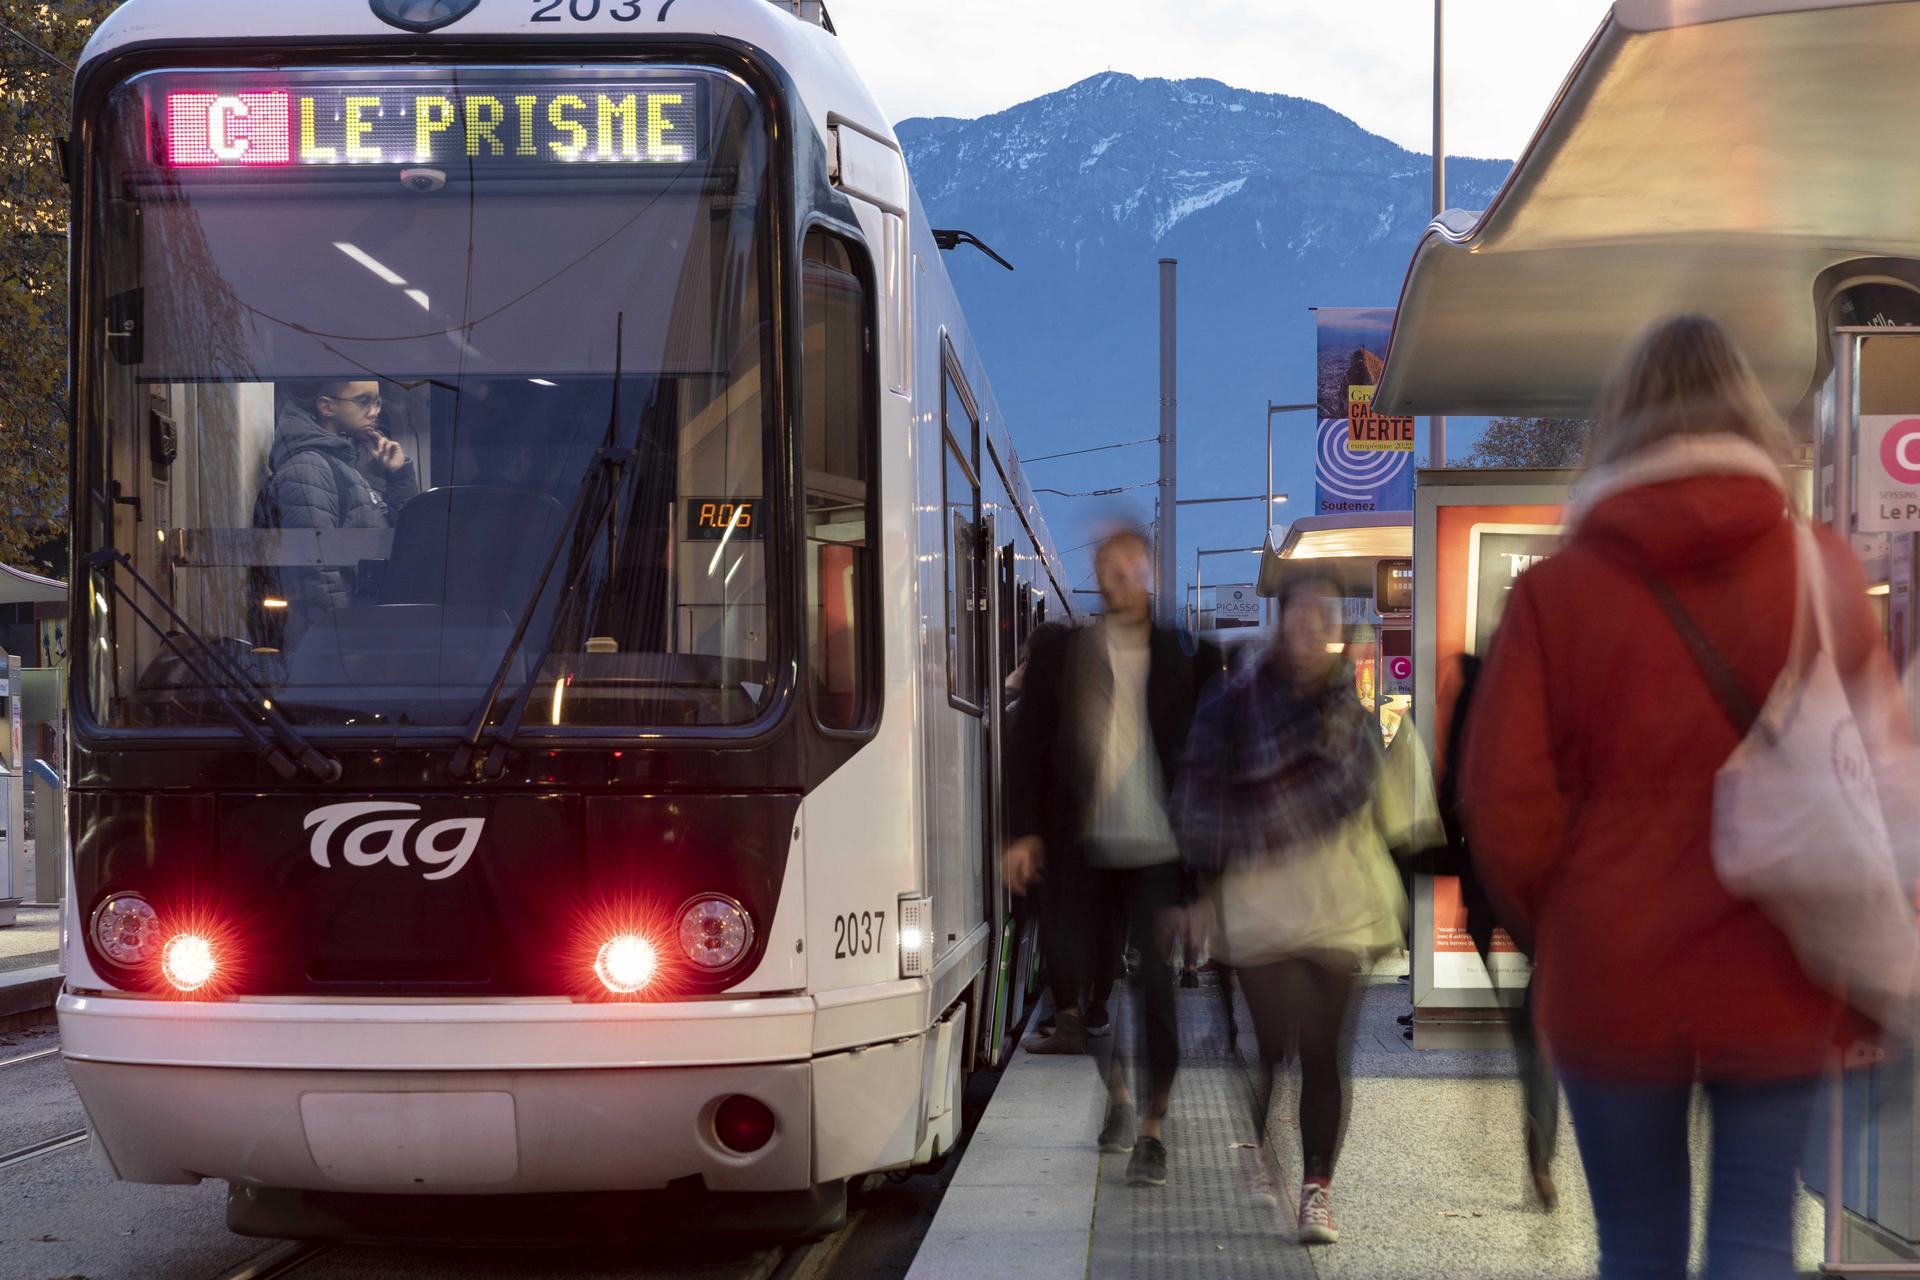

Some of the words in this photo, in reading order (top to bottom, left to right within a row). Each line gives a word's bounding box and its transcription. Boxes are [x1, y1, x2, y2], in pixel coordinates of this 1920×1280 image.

[530, 0, 676, 22] 2037
[207, 95, 249, 160] C
[300, 96, 382, 158] LE
[415, 94, 683, 157] PRISME
[1351, 419, 1413, 441] VERTE
[1321, 501, 1376, 511] Soutenez
[1880, 504, 1902, 520] Le
[1216, 603, 1260, 612] PICASSO
[1394, 661, 1406, 676] C
[303, 801, 486, 880] Tag
[834, 910, 885, 959] 2037
